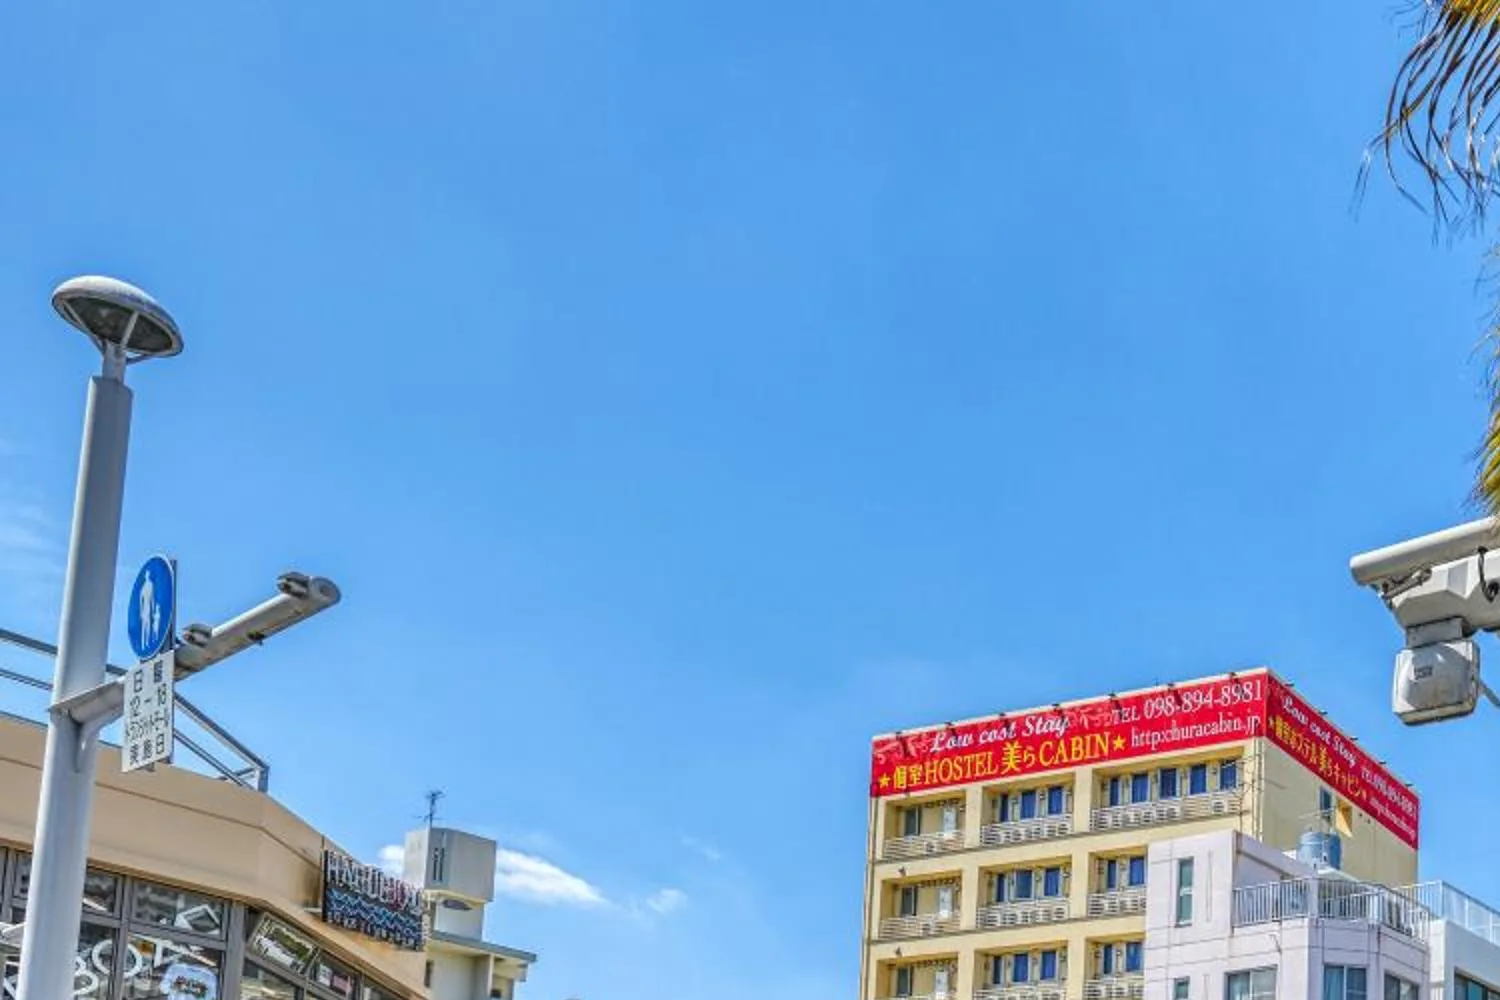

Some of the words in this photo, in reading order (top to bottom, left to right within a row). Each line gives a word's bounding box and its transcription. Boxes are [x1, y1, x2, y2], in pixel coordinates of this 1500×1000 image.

[1112, 705, 1140, 724] TEL
[930, 732, 973, 753] Low
[979, 722, 1017, 745] cost
[1021, 715, 1069, 738] Stay
